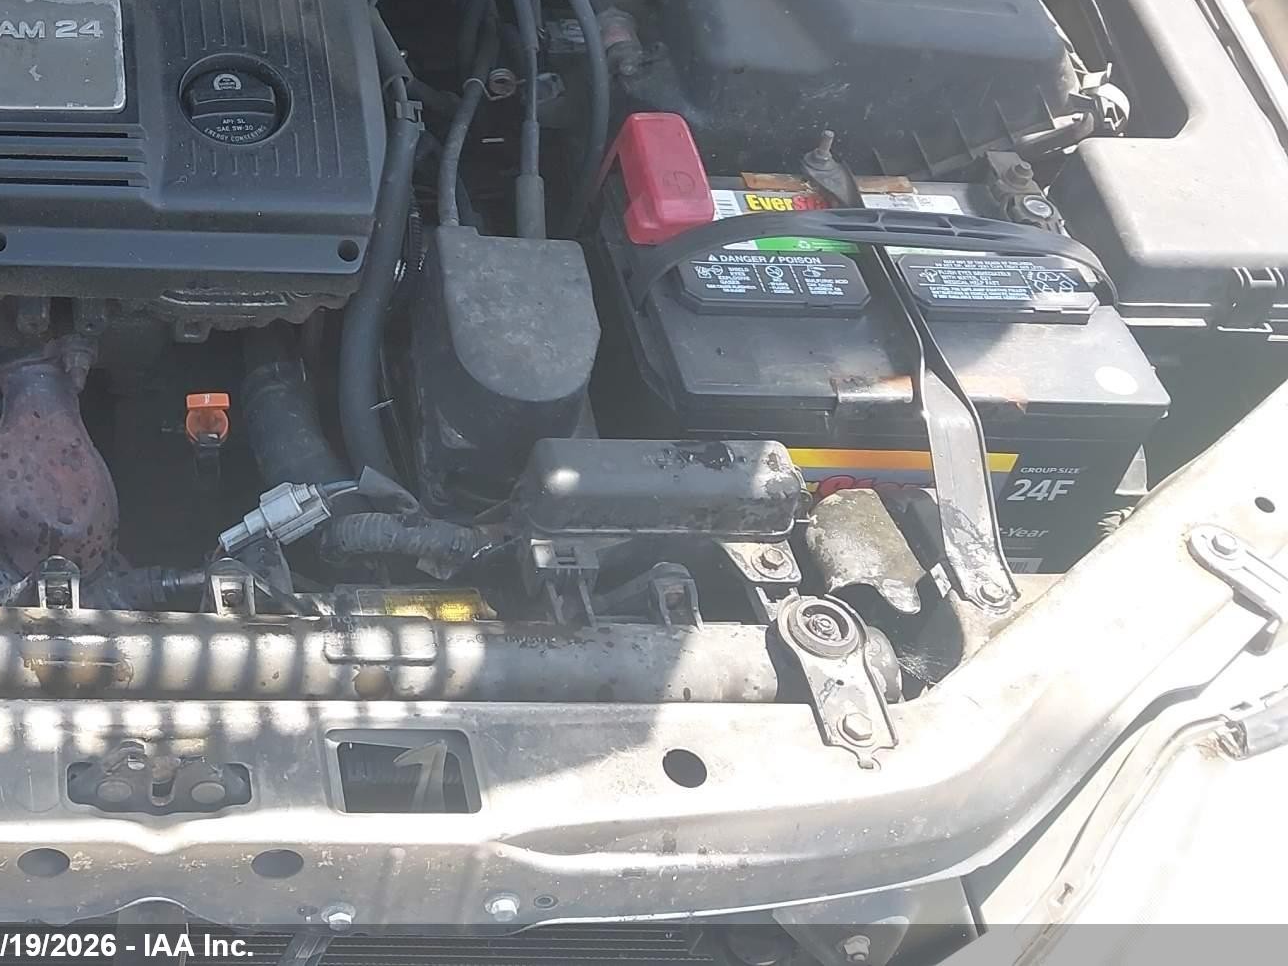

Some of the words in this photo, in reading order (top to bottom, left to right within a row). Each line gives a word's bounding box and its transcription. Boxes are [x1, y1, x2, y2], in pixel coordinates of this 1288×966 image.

[54, 20, 103, 39] 24
[719, 255, 767, 263] DANGER
[778, 256, 822, 264] POISON
[1020, 466, 1056, 474] GROUP
[1058, 466, 1081, 474] SIZE
[1006, 478, 1076, 502] 24F
[999, 525, 1049, 538] -Year
